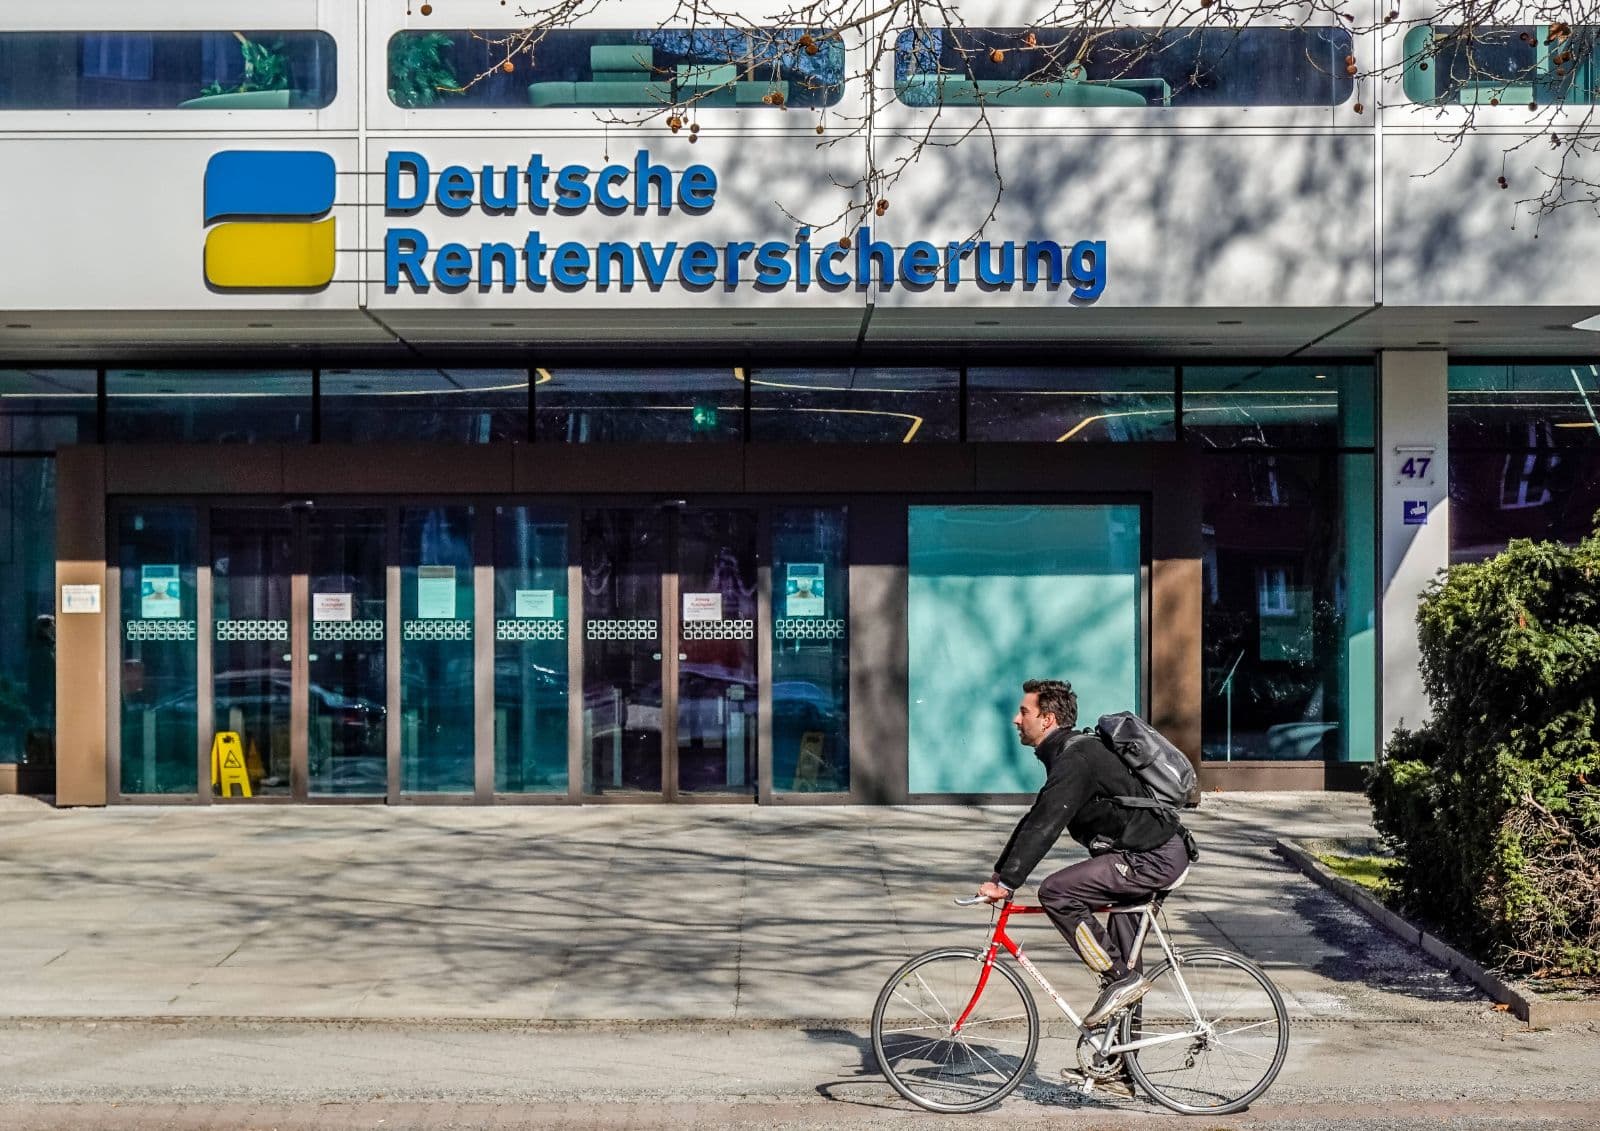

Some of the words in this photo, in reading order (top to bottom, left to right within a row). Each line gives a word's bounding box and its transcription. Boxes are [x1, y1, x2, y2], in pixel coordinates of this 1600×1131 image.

[385, 151, 717, 211] Deutsche
[385, 226, 1107, 301] Rentenversicherung
[1401, 457, 1431, 478] 47
